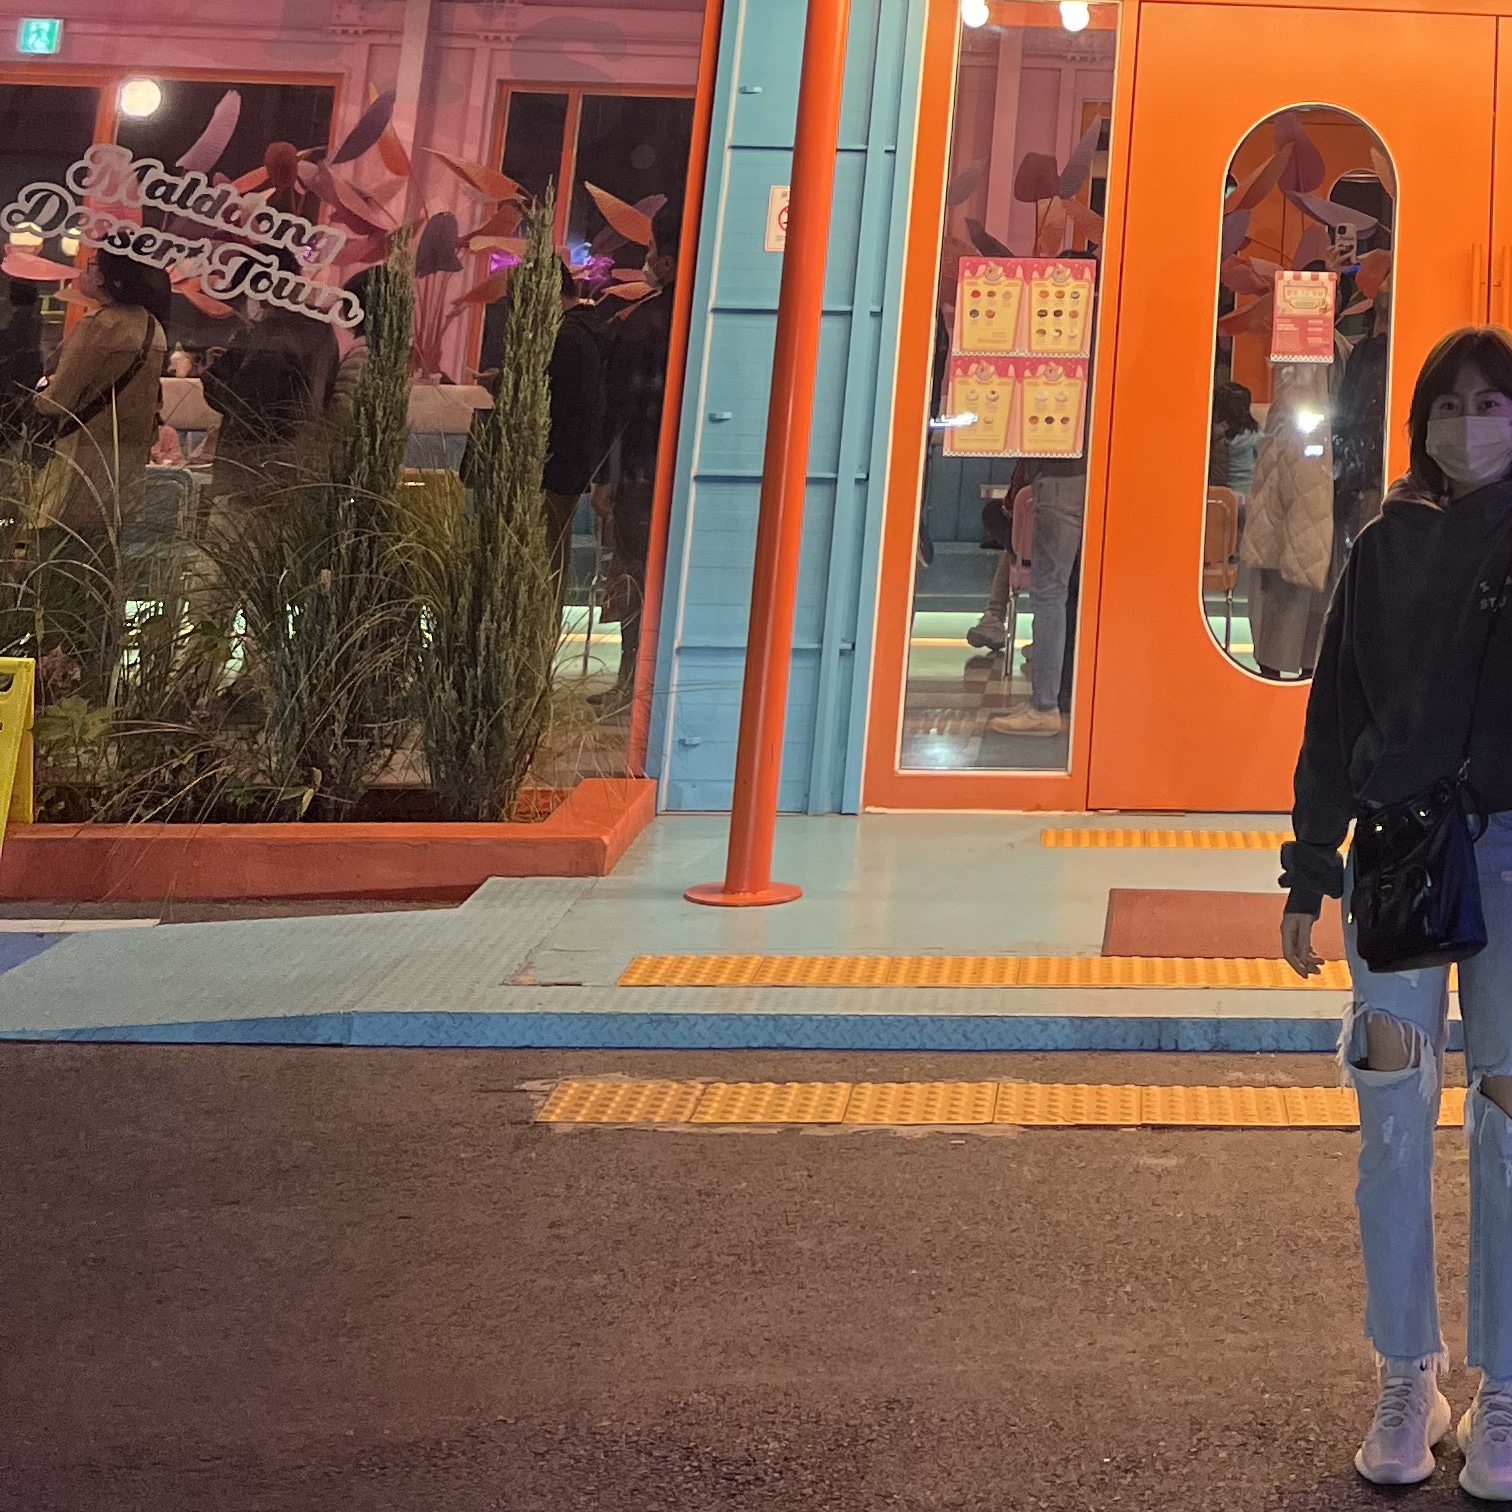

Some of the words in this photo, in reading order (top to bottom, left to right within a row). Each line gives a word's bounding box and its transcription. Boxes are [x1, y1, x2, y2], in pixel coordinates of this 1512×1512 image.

[1, 182, 211, 278] Dessert
[200, 241, 366, 328] Town
[66, 143, 348, 270] Malddong
